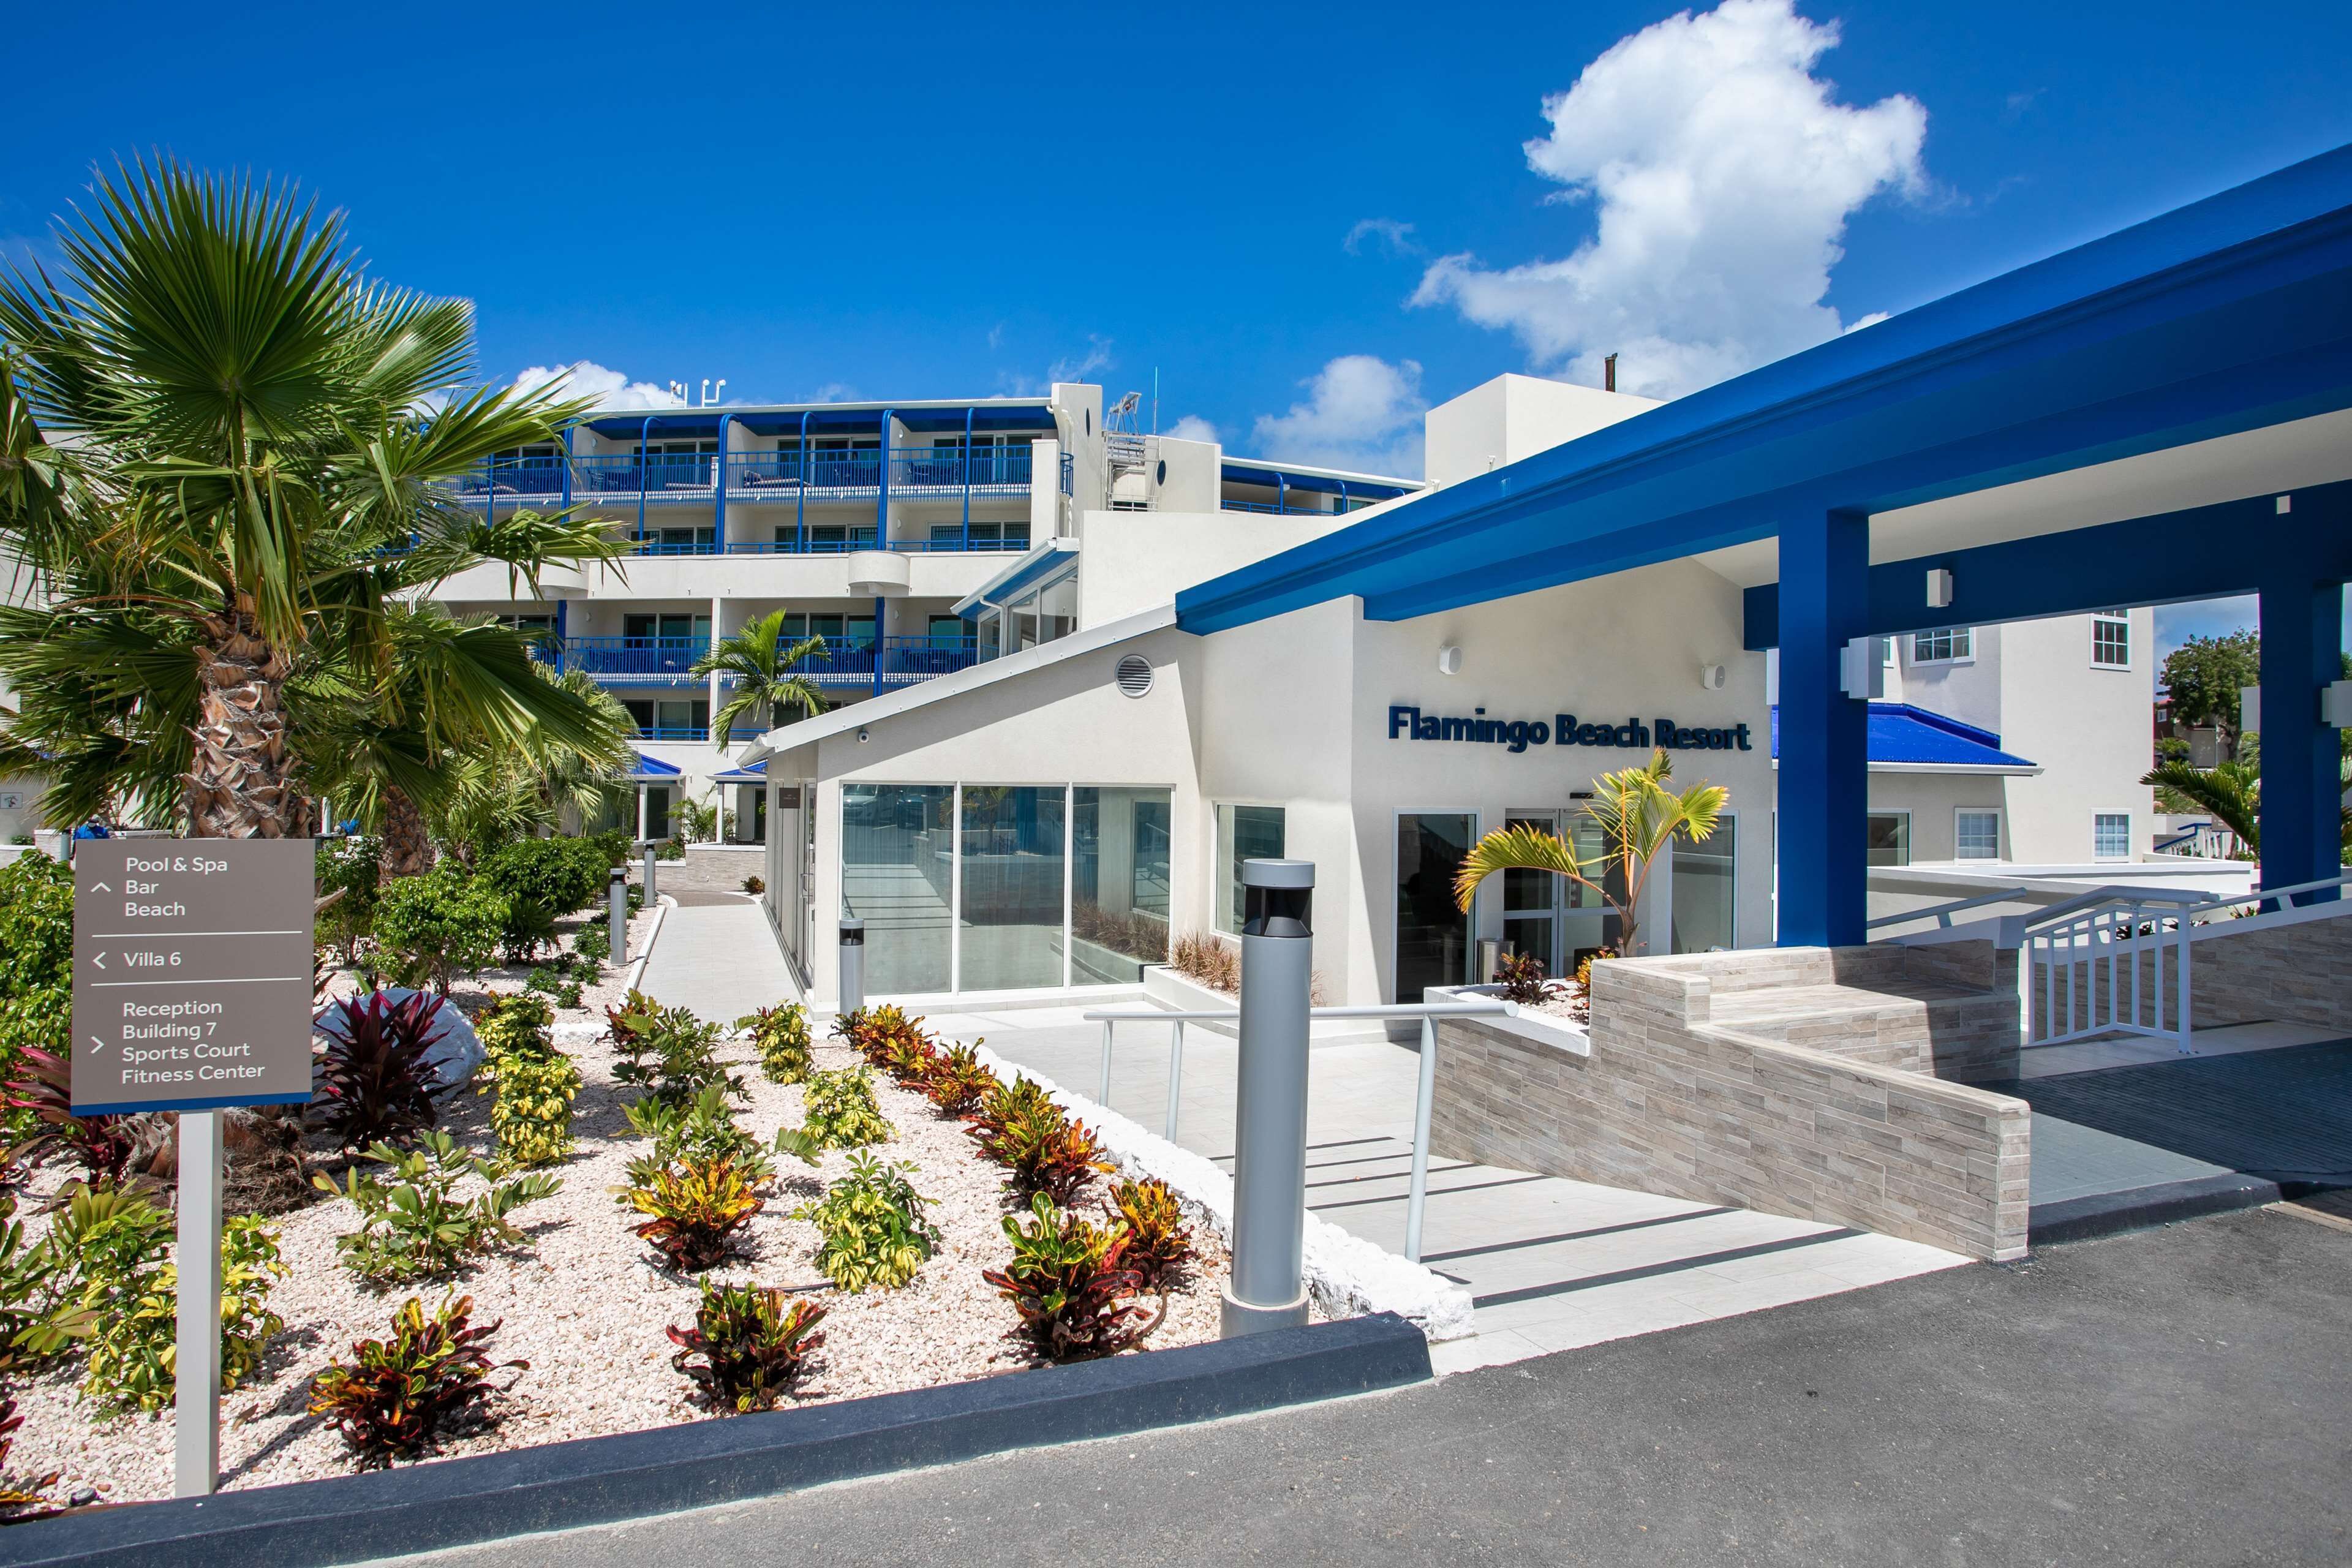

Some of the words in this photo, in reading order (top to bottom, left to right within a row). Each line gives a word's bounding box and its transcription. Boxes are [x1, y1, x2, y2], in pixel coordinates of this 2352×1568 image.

[1389, 706, 1550, 753] Flamingo
[1555, 714, 1650, 748] Beach
[1654, 718, 1752, 752] Resort
[126, 857, 169, 872] Pool
[173, 857, 187, 872] &
[192, 857, 228, 875] Spa
[126, 880, 159, 894] Bar
[125, 902, 186, 917] Beach
[123, 952, 165, 967] Villa
[170, 951, 181, 966] 6
[123, 1000, 222, 1019] Reception
[123, 1023, 201, 1041] Building
[206, 1022, 217, 1036] 7
[122, 1046, 189, 1065] Sports
[194, 1042, 251, 1058] Court
[122, 1069, 194, 1084] Fitness
[198, 1065, 266, 1080] Center
